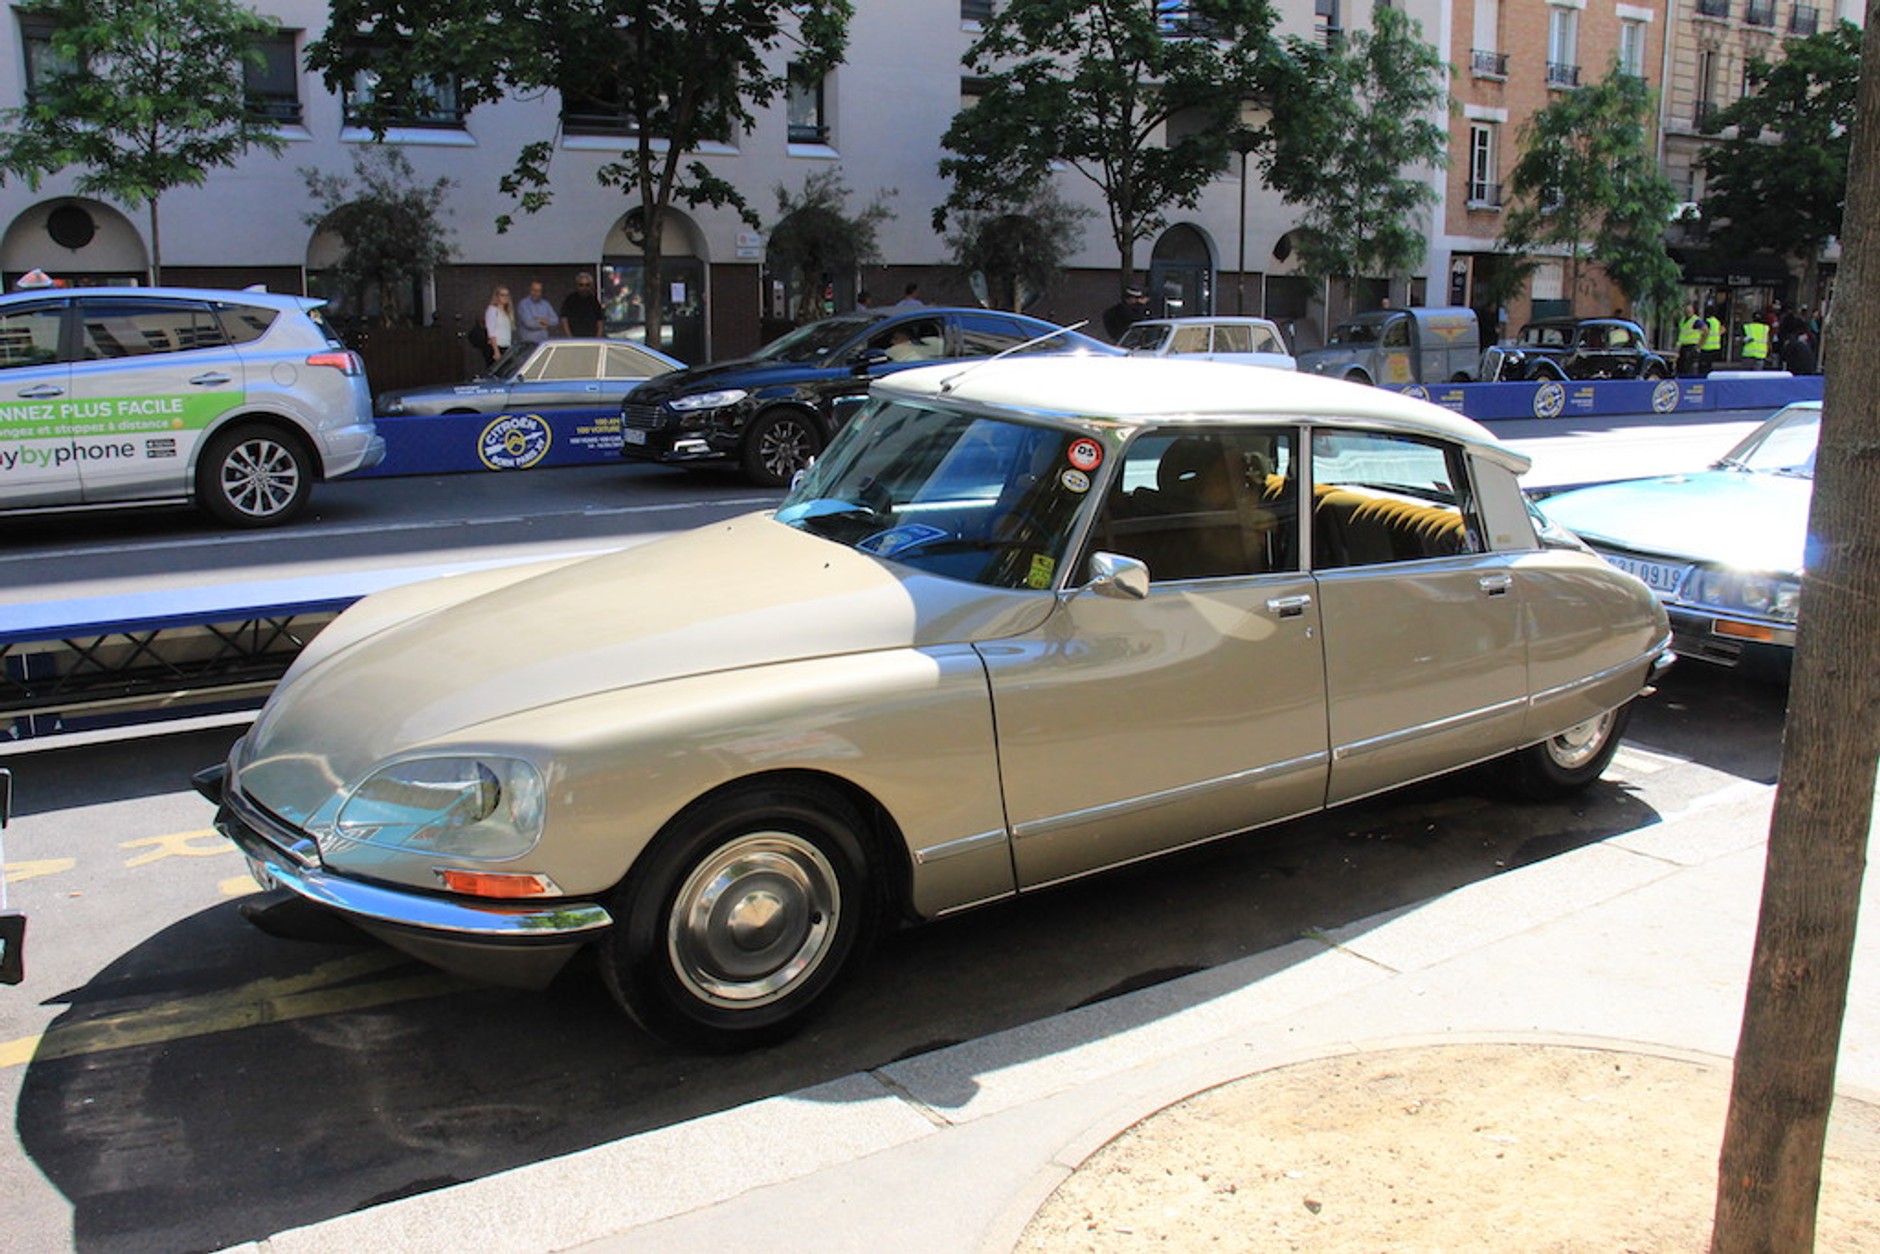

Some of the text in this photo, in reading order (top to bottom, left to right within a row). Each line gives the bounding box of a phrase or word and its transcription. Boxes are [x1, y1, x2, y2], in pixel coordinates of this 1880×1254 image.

[60, 401, 112, 419] PLUS
[117, 398, 184, 416] FACILE
[55, 422, 105, 436] stoppez
[119, 417, 169, 431] distance
